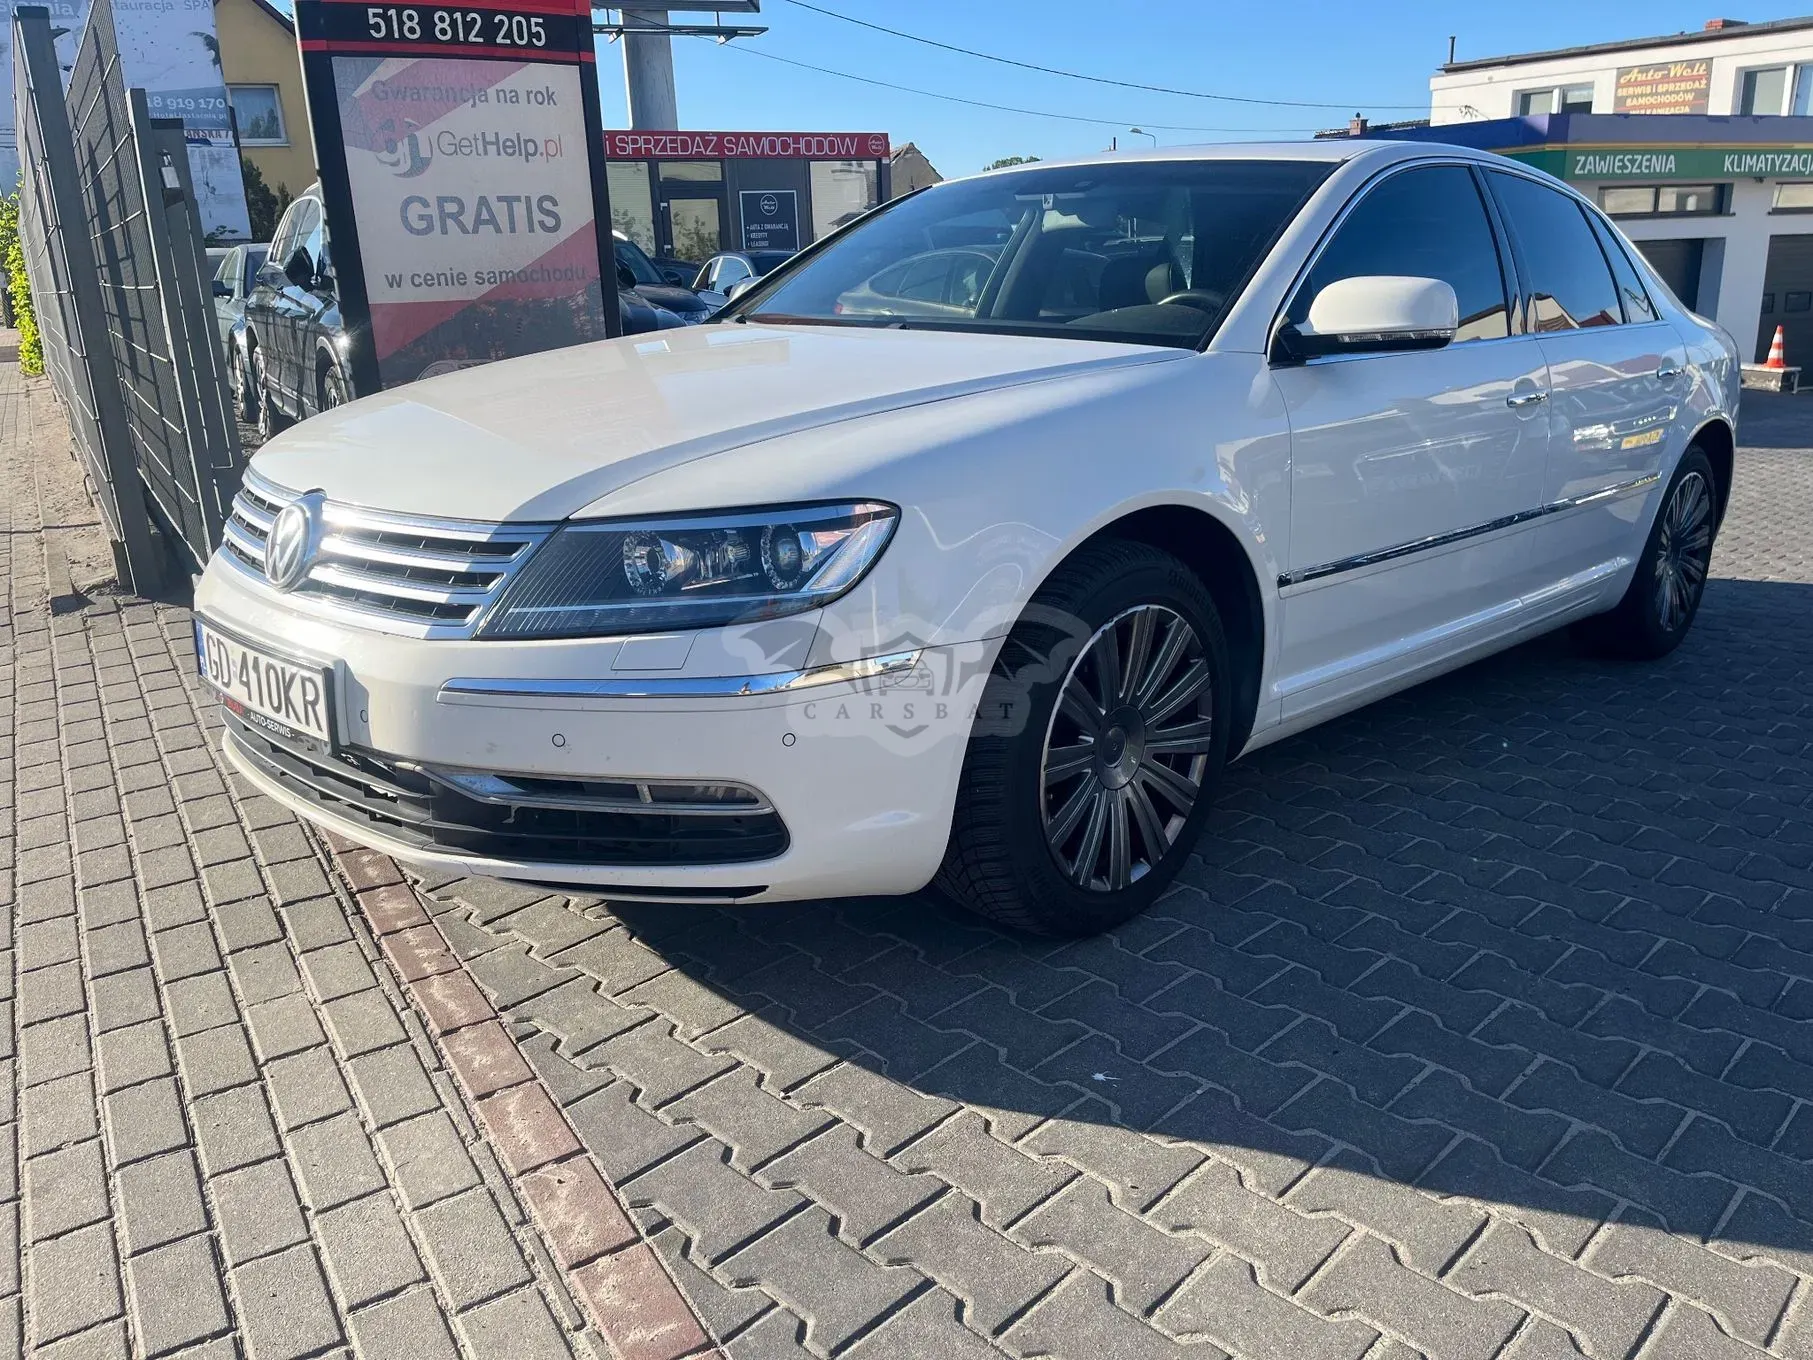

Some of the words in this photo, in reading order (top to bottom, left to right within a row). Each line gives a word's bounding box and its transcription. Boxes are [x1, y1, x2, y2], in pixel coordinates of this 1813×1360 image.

[367, 7, 422, 41] 518
[433, 10, 485, 43] 812
[493, 14, 547, 47] 205
[166, 97, 195, 110] 919
[198, 97, 226, 110] 170
[371, 79, 489, 109] Gwarancja
[495, 86, 520, 105] na
[525, 85, 558, 106] rok
[1625, 92, 1696, 107] SAMOCHODÓW
[436, 130, 564, 163] GetHelp.pl
[605, 134, 611, 155] i
[616, 132, 718, 156] SPRZEDAŻ
[723, 133, 858, 156] SAMOCHODÓW
[1574, 153, 1676, 176] ZAWIESZENIA
[399, 194, 562, 237] GRATIS
[384, 271, 402, 289] w
[410, 266, 468, 289] cenie
[474, 263, 587, 287] samochodu
[206, 632, 232, 690] GD
[238, 650, 324, 733] 410KR
